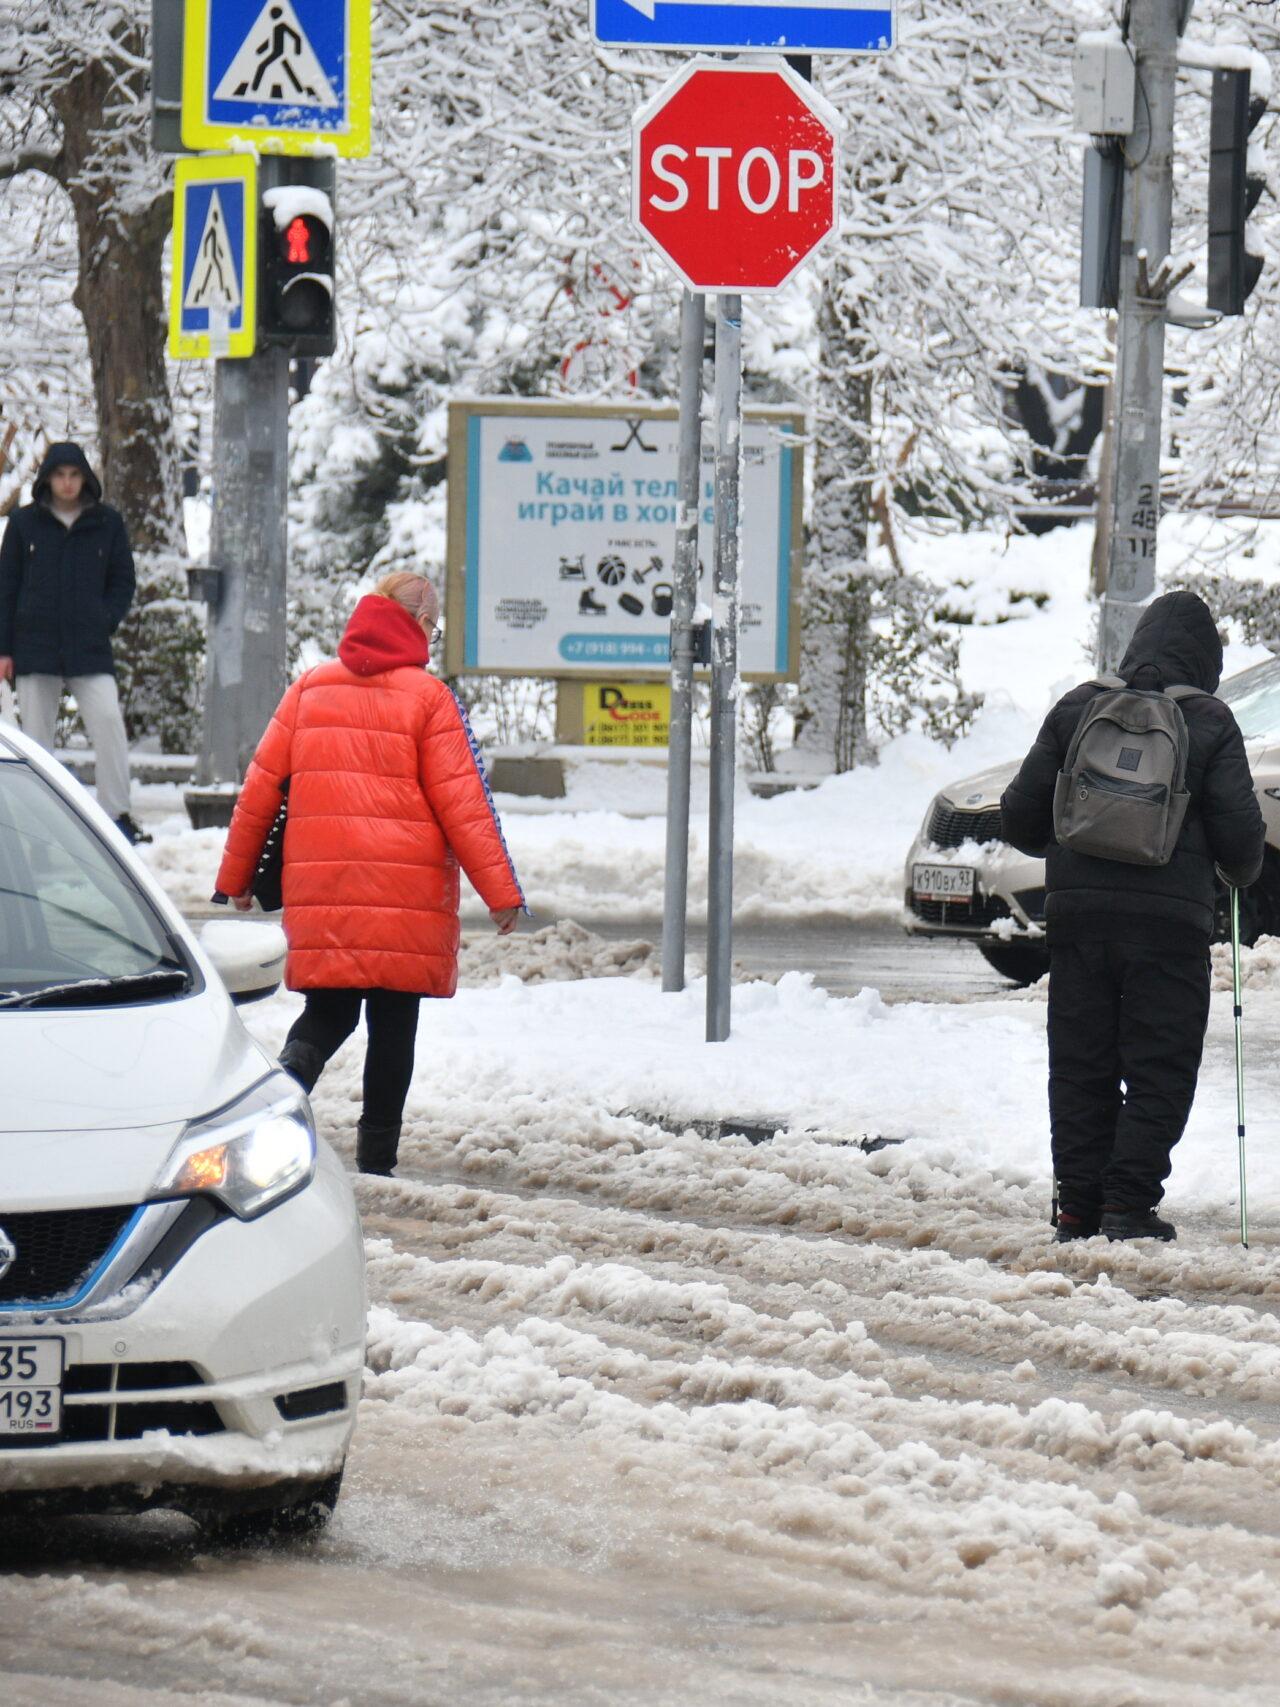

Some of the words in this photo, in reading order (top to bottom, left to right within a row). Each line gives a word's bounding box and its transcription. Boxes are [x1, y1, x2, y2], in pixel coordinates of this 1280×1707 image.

[649, 144, 825, 214] STOP
[536, 470, 624, 496] Качай
[633, 480, 678, 497] тел
[1138, 484, 1153, 505] 2
[518, 499, 604, 526] играй
[613, 504, 628, 521] в
[0, 1390, 52, 1418] 193
[10, 1420, 34, 1430] RUS
